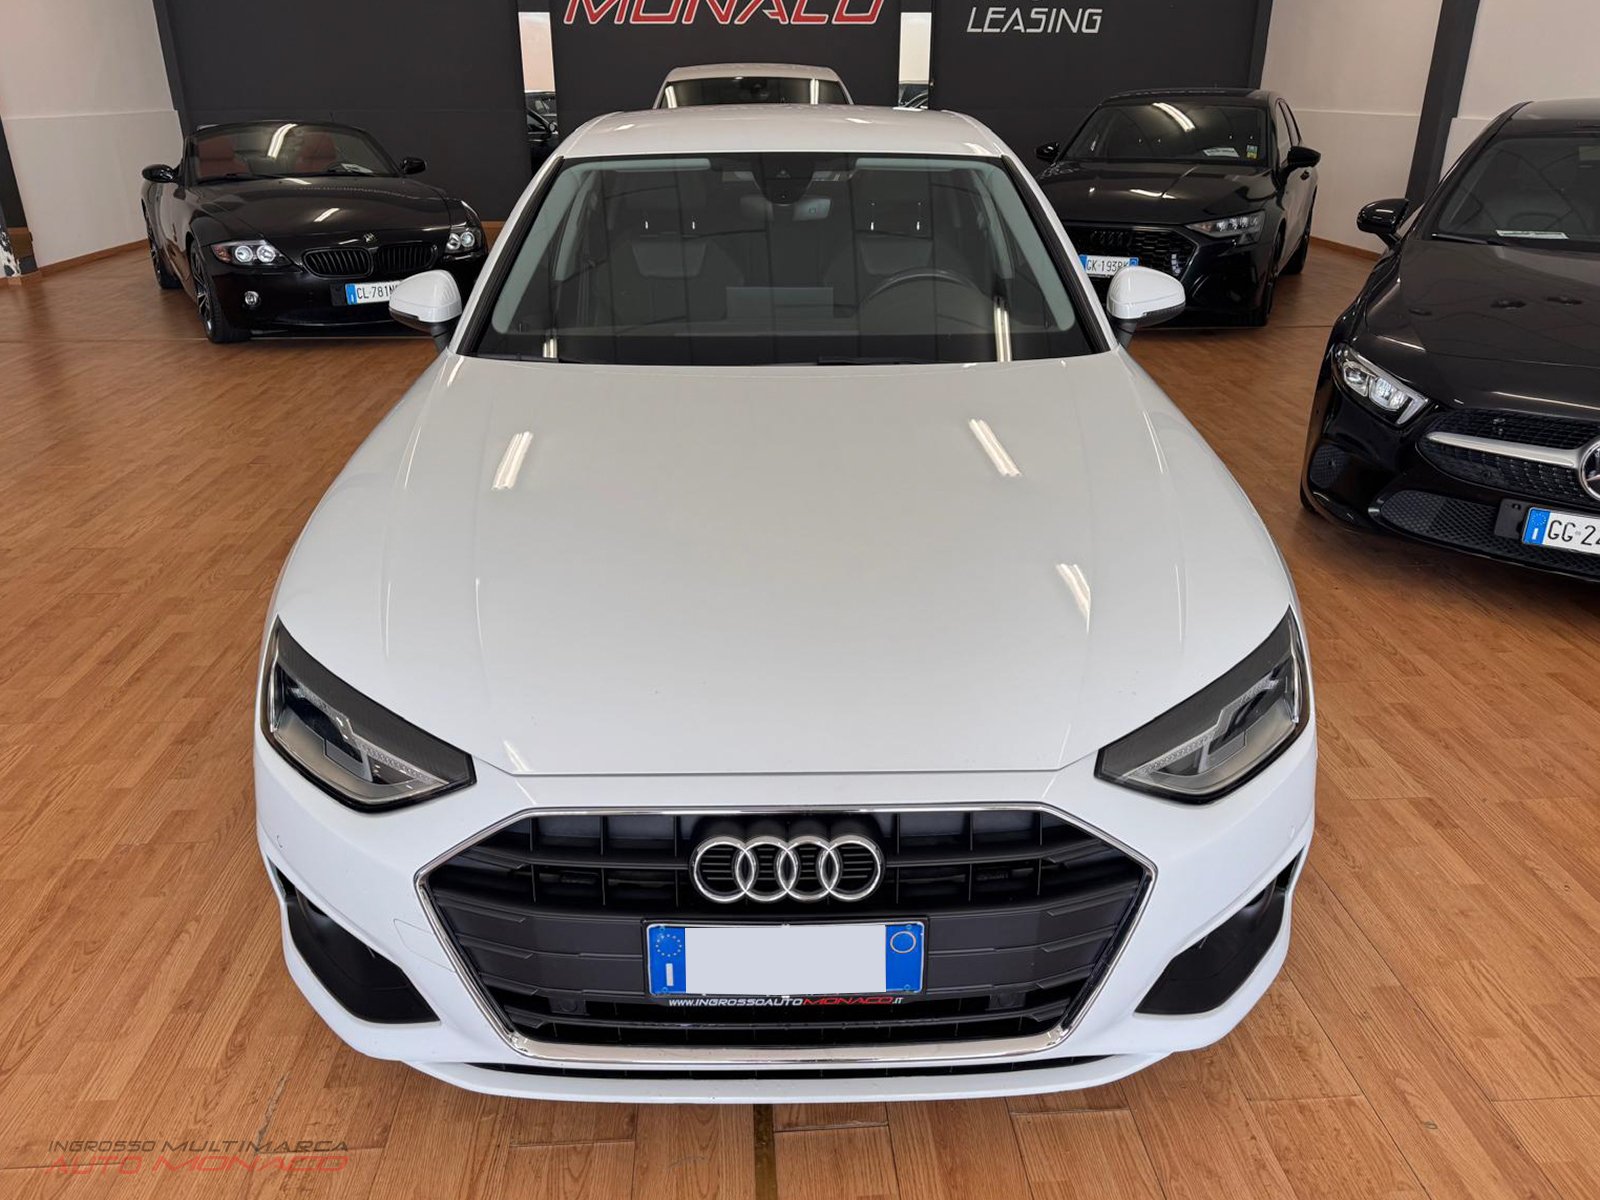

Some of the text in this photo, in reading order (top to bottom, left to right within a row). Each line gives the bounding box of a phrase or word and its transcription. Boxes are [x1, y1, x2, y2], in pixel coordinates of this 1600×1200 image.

[967, 6, 1102, 33] LEASING
[371, 284, 398, 298] 781N
[1548, 520, 1576, 542] GG
